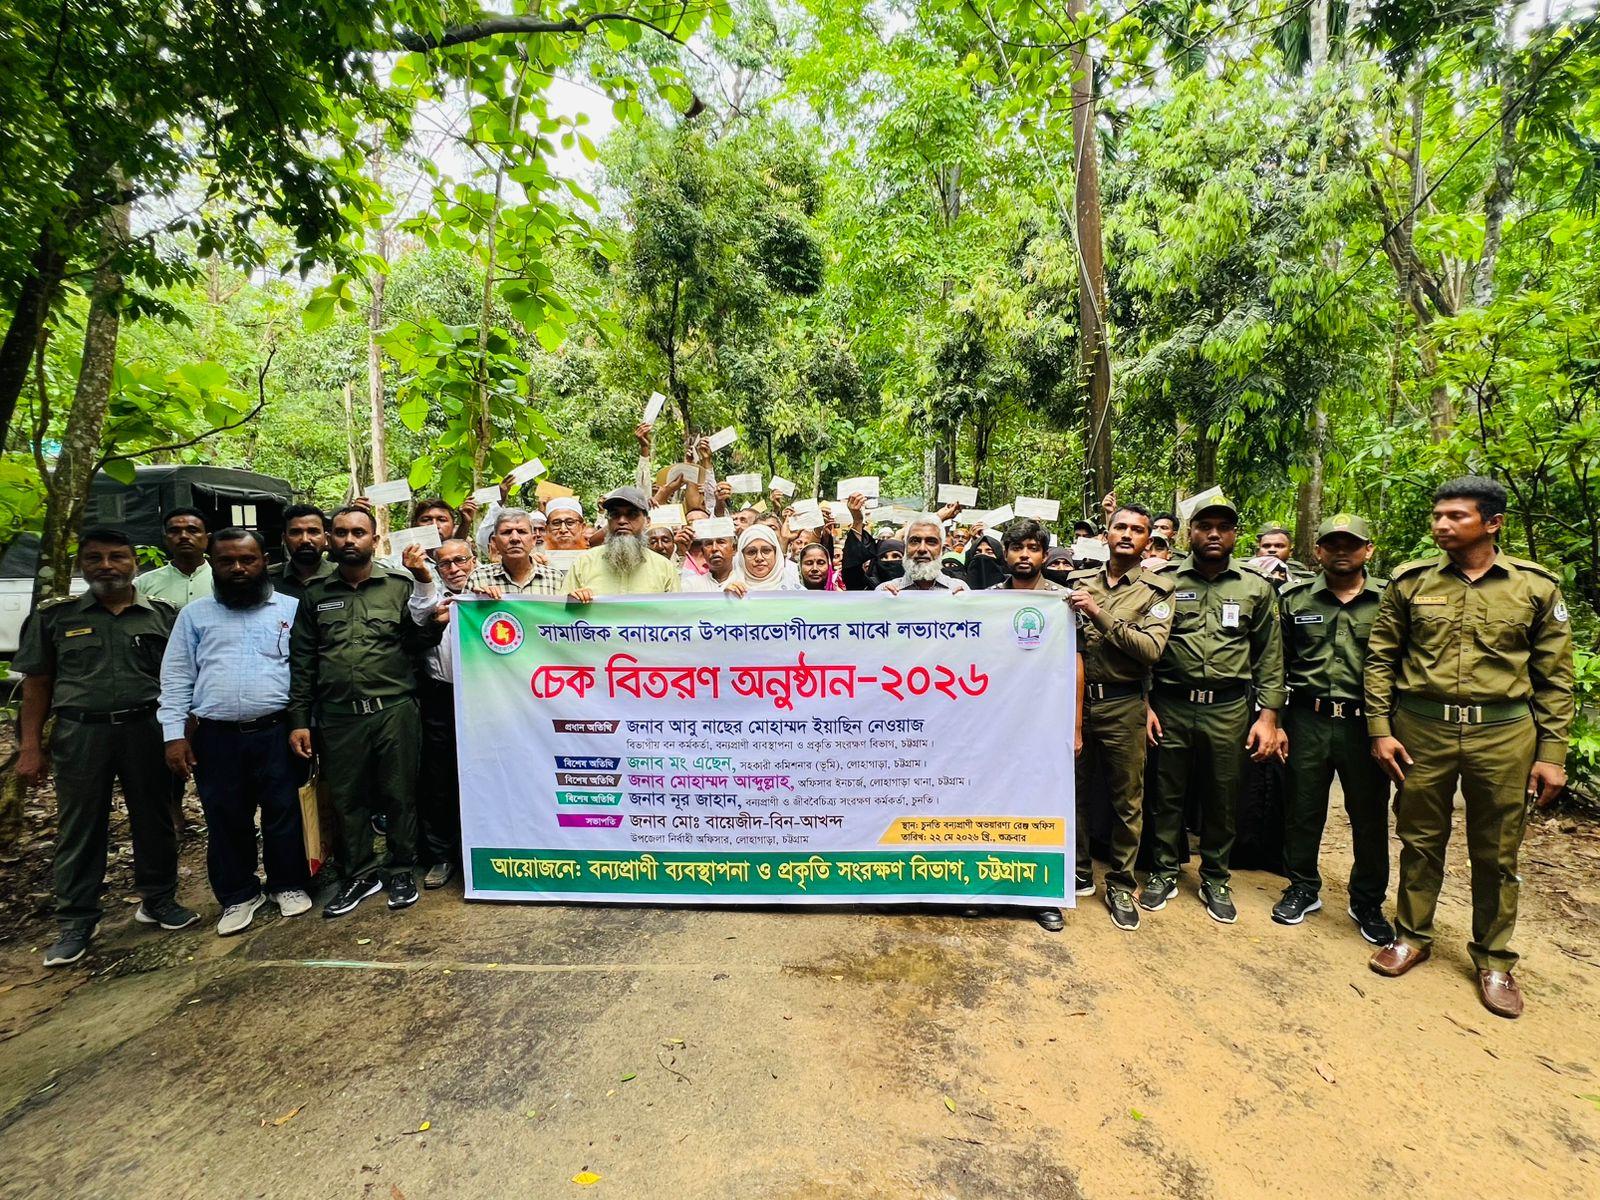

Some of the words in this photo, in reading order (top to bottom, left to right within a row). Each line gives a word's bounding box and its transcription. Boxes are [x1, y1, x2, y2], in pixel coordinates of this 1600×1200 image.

[538, 620, 611, 643] সামাজিক
[617, 624, 693, 643] বনায়নের
[700, 617, 841, 643] উপকারভোগীদের
[846, 621, 890, 640] মাঝে
[896, 619, 982, 640] লভ্যাংশের
[530, 665, 595, 699] চেক
[605, 653, 720, 699] বিতরণ
[729, 651, 989, 711] অনুষ্ঠান-২০২৬
[564, 722, 585, 732] প্রধান
[586, 721, 613, 732] অতিথি
[626, 719, 665, 734] জনাব
[669, 719, 698, 737] আবু
[701, 719, 743, 735] নাছের
[749, 719, 808, 735] মোহাম্মদ
[812, 716, 863, 735] ইয়াছিন
[868, 718, 925, 733] নেওয়াজ
[626, 738, 661, 749] বিভাগীয়
[663, 741, 675, 749] বন
[678, 739, 712, 750] কর্মকর্তা,
[716, 738, 749, 750] বন্যপ্রাণী
[752, 741, 793, 752] ব্যবস্থাপনা
[807, 739, 831, 752] প্রকৃতি
[835, 740, 866, 750] সংরক্ষণ
[870, 738, 898, 750] বিভাগ,
[563, 758, 587, 768] বিশেষ
[589, 758, 614, 768] অতিথি
[626, 756, 665, 771] জনাব
[670, 757, 688, 771] মং
[692, 756, 736, 773] এছেন,
[740, 759, 771, 770] সহকারী
[774, 759, 812, 770] কমিশনার
[565, 775, 588, 785] বিশেষ
[590, 775, 615, 785] অতিথি
[627, 774, 666, 788] জনাব
[671, 774, 728, 789] মোহাম্মদ
[733, 775, 794, 791] আব্দুল্লাহ,
[798, 778, 832, 788] অফিসার
[869, 777, 910, 787] লোহাগাড়া
[913, 778, 934, 787] থানা,
[565, 793, 588, 803] বিশেষ
[590, 793, 616, 803] অতিথি
[628, 792, 666, 806] জনাব
[670, 793, 690, 811] নূর
[694, 793, 741, 810] জাহান,
[745, 796, 779, 807] বন্যপ্রাণী
[840, 797, 871, 806] সংরক্ষণ
[911, 794, 933, 807] চুনতি
[585, 815, 616, 826] সভাপতি
[629, 814, 667, 828] জনাব
[672, 815, 700, 829] মোঃ
[921, 819, 941, 831] চুনতি
[943, 819, 973, 830] বন্যপ্রাণী
[1031, 821, 1055, 830] অফিস
[631, 833, 665, 844] উপজেলা
[668, 833, 693, 844] নির্বাহী
[696, 834, 732, 845] অফিসার,
[930, 834, 941, 842] ২২
[943, 833, 954, 841] মে
[490, 856, 581, 880] আয়োজনে:
[587, 853, 658, 882] বন্যপ্রাণী
[663, 860, 751, 886] ব্যবস্থাপনা
[755, 863, 771, 880] ও
[778, 855, 831, 891] প্রকৃতি
[836, 858, 905, 883] সংরক্ষণ
[909, 853, 970, 884] বিভাগ,
